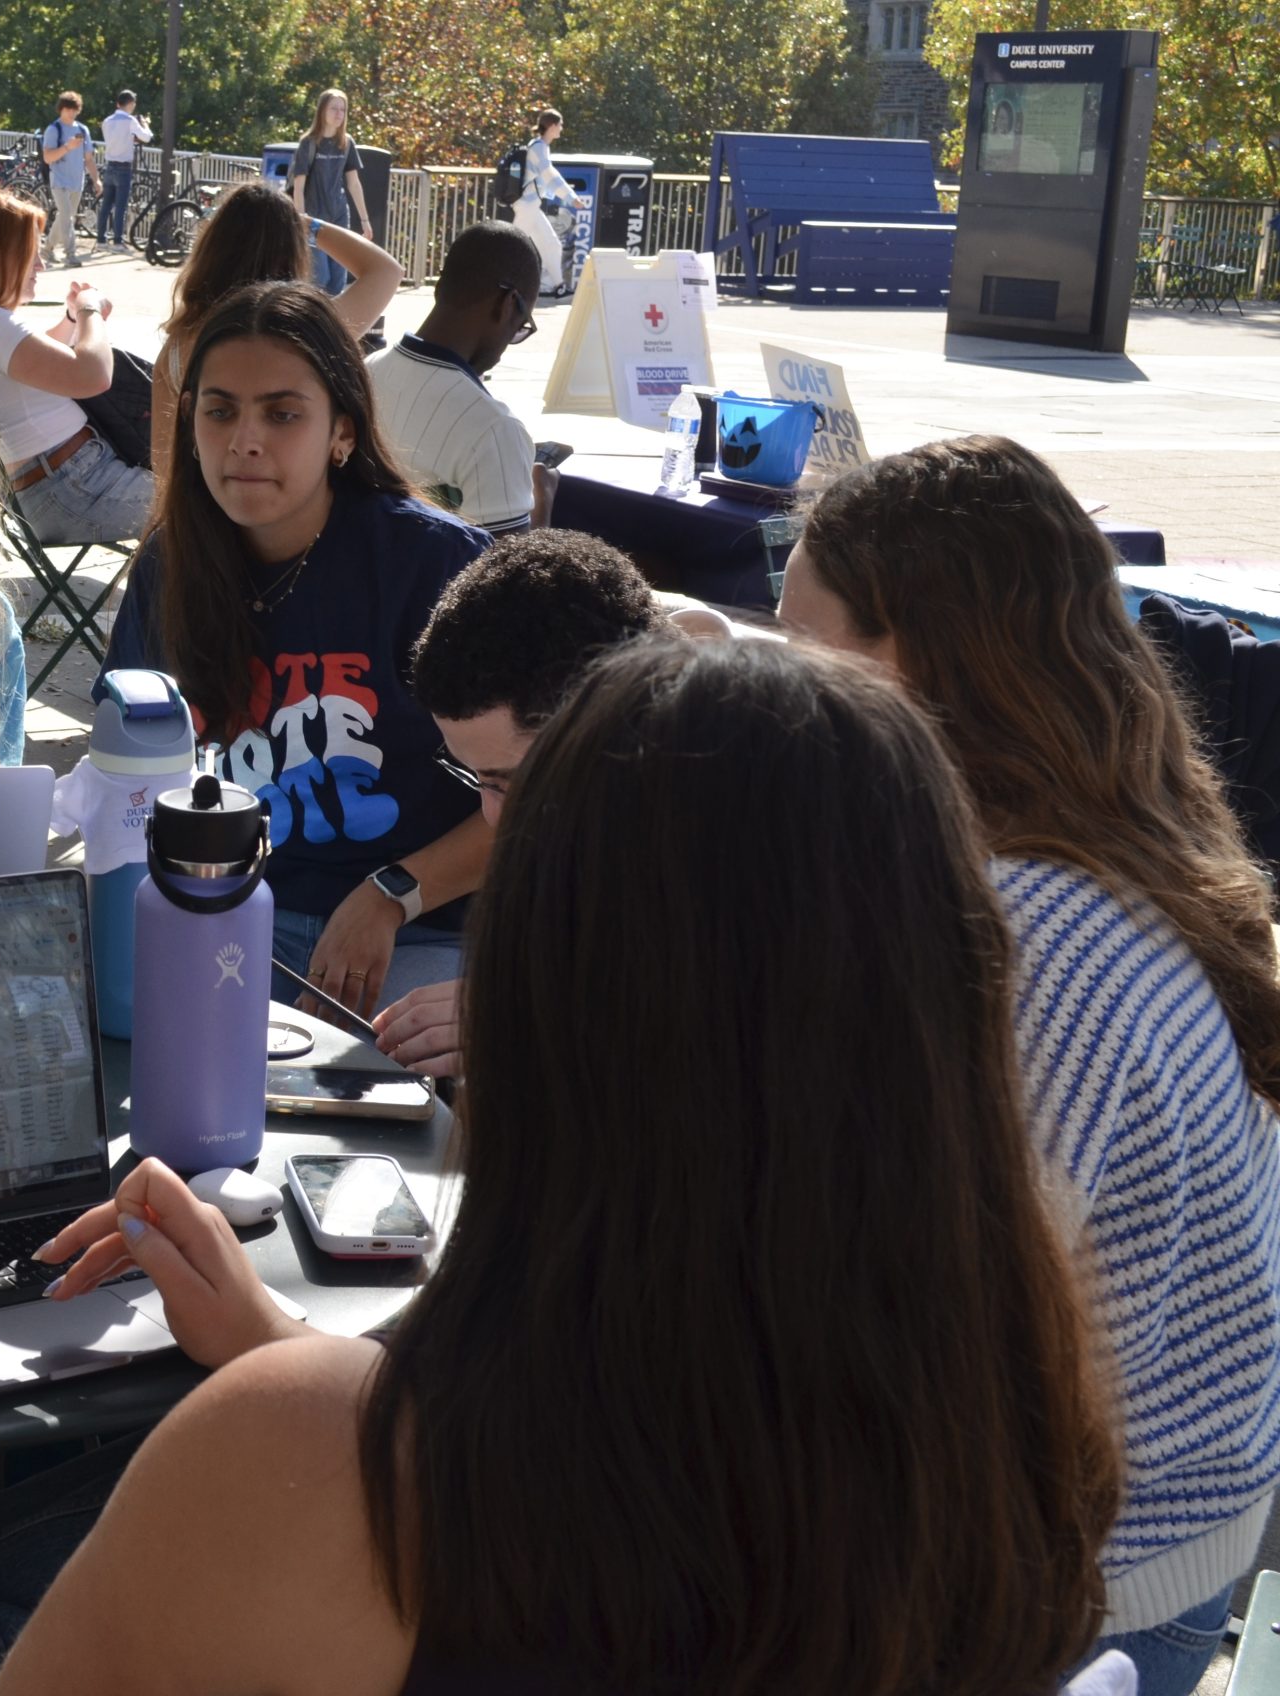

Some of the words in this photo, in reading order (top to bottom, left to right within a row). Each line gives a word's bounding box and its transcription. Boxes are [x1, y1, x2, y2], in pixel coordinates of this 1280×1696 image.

[1011, 45, 1036, 55] DUKE
[1039, 44, 1094, 55] UNIVERSITY
[1010, 60, 1038, 69] CAMPUS
[1039, 60, 1066, 69] CENTER
[636, 368, 664, 379] BLOOD
[665, 369, 690, 380] DRIVE
